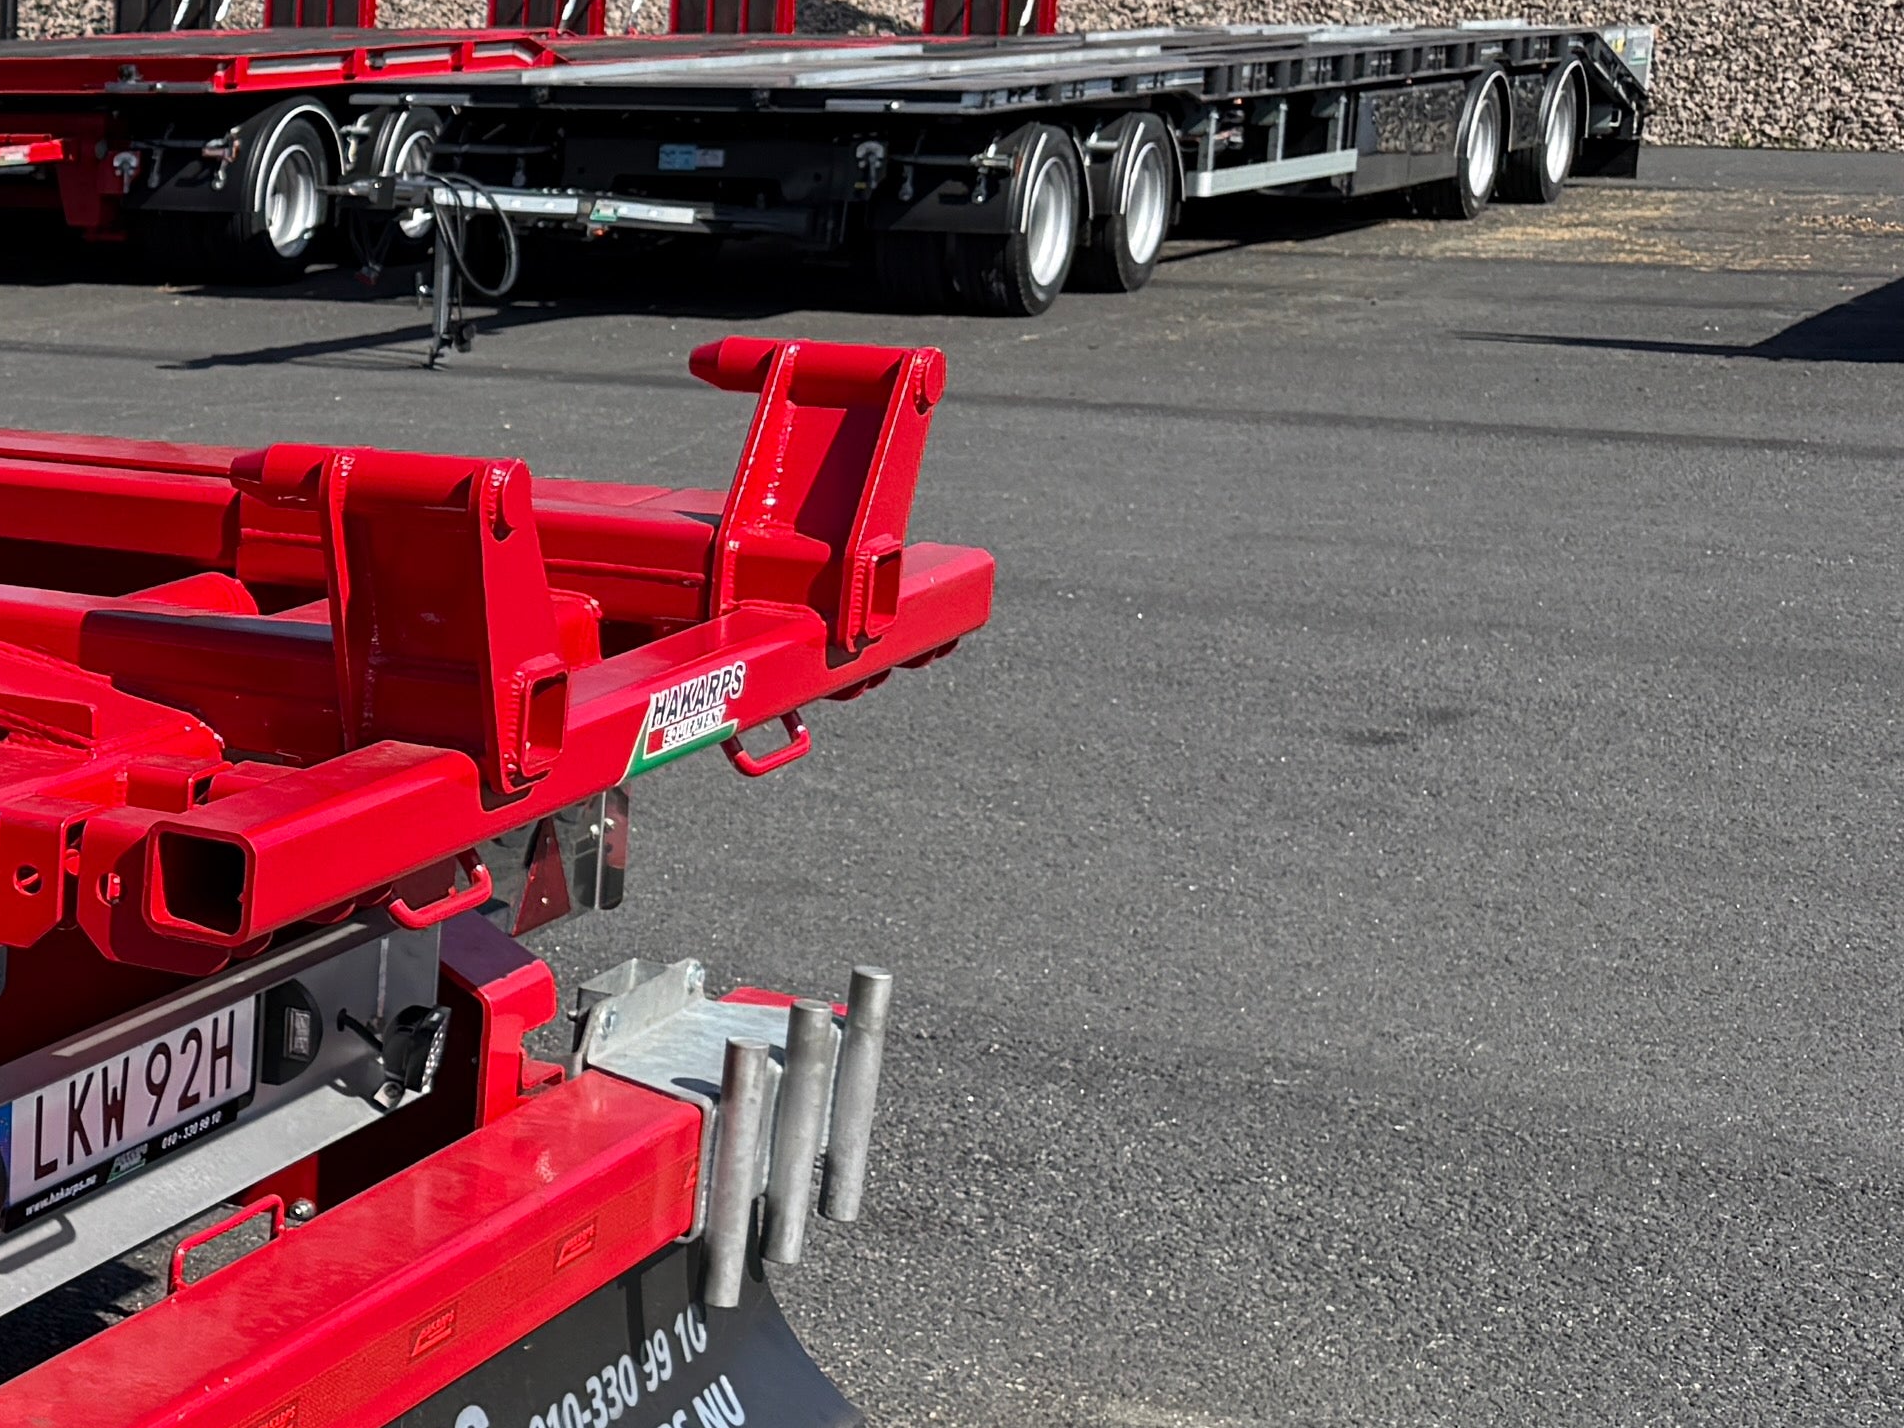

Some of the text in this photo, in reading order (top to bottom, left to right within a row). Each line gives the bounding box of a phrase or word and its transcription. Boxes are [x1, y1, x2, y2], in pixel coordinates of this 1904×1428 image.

[650, 662, 745, 726] HAKARPS
[664, 707, 724, 741] EQUIPMENT
[33, 1009, 235, 1181] LKW 92H
[674, 1302, 707, 1363] 10
